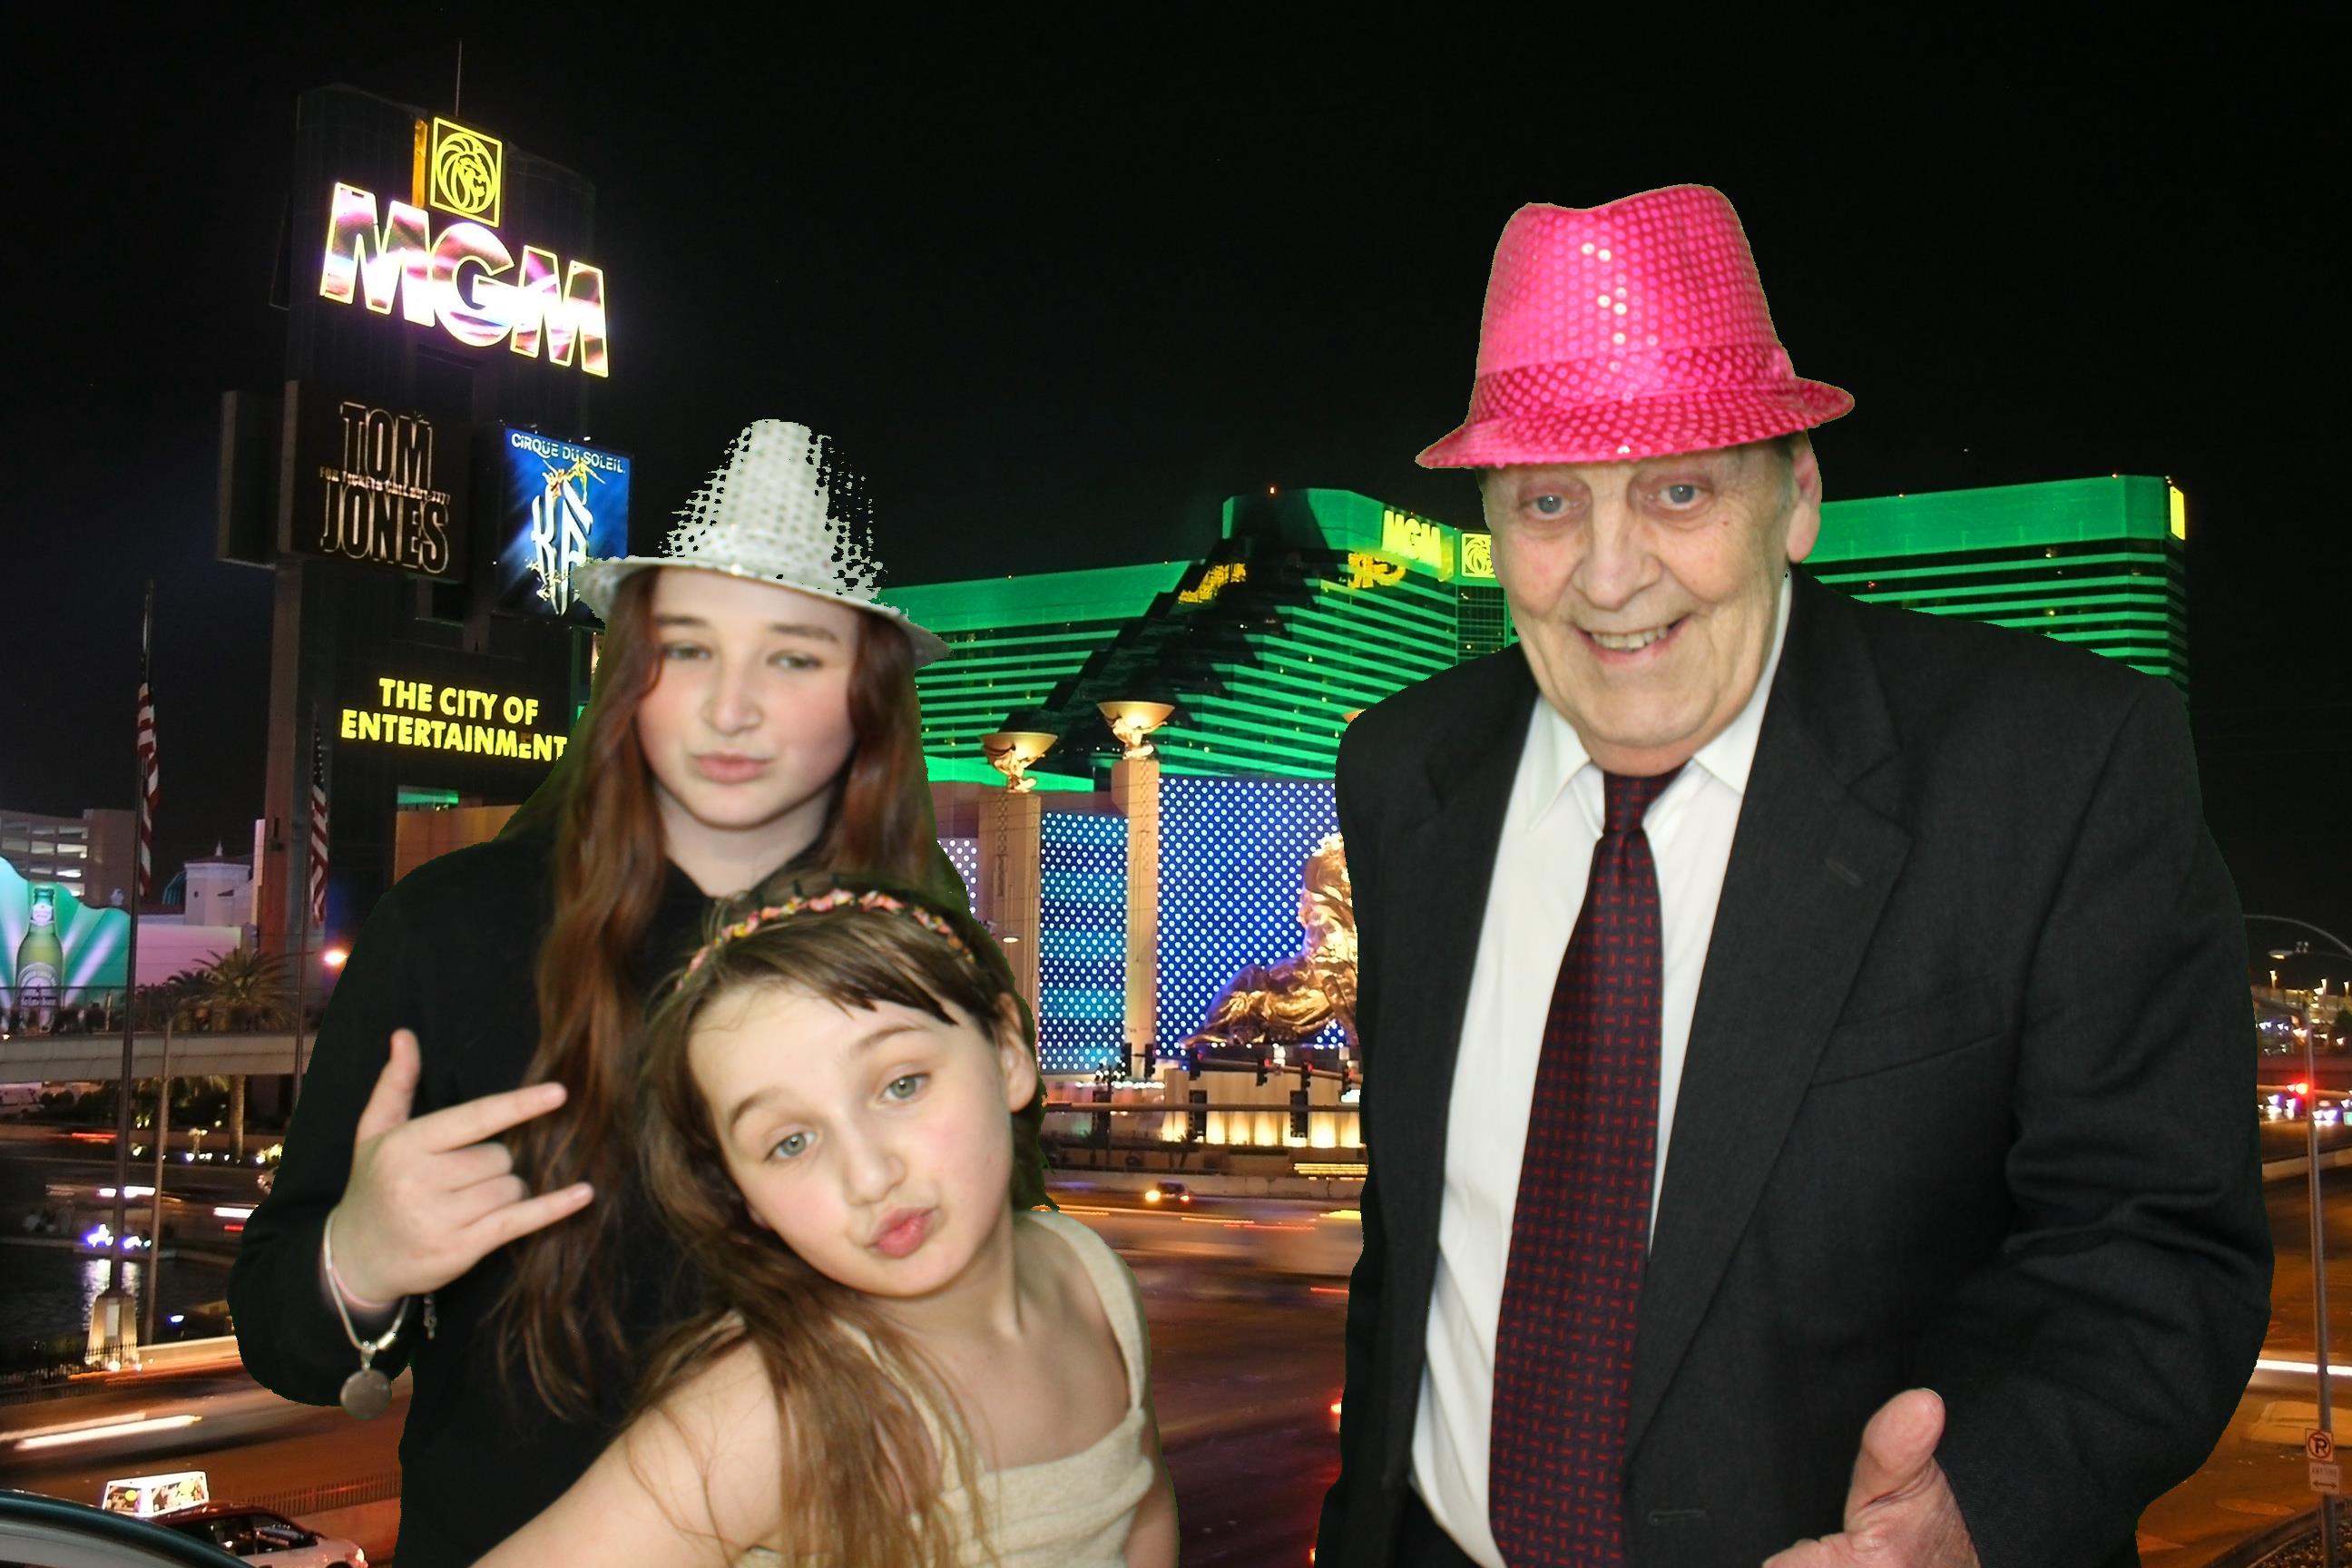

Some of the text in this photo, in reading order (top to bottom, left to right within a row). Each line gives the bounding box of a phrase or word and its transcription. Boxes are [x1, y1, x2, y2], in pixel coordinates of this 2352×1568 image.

[320, 181, 609, 378] MGM
[339, 400, 433, 488] TOM
[511, 433, 624, 474] CIRQUE DU SOLEIL
[320, 482, 449, 574] JONES
[1381, 510, 1443, 569] MGM
[378, 677, 539, 726] THE CITY OF
